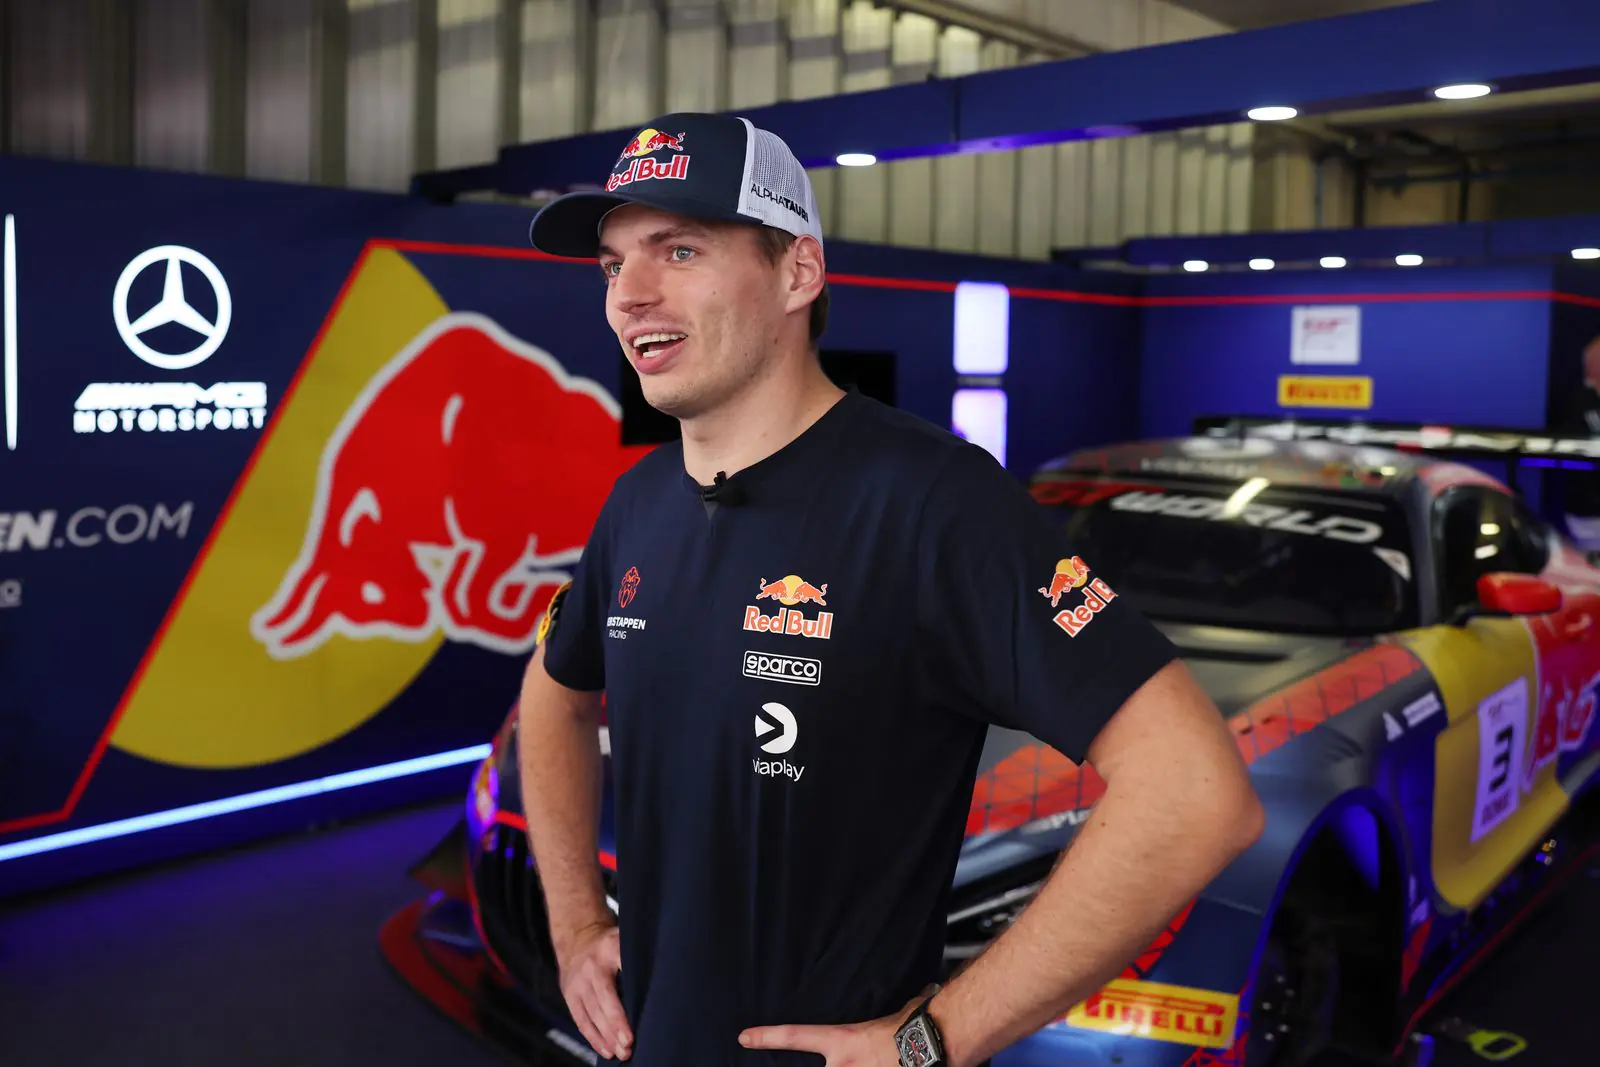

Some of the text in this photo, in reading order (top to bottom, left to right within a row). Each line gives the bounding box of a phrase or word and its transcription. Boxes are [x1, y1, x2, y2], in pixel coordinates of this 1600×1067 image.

[635, 155, 690, 182] Bull
[73, 407, 267, 434] MOTORSPORT
[1111, 491, 1383, 543] WORLD
[743, 605, 834, 640] Red Bull
[1053, 587, 1107, 638] Red
[608, 629, 628, 640] RACING
[745, 654, 819, 679] sparco
[752, 757, 806, 782] viaplay
